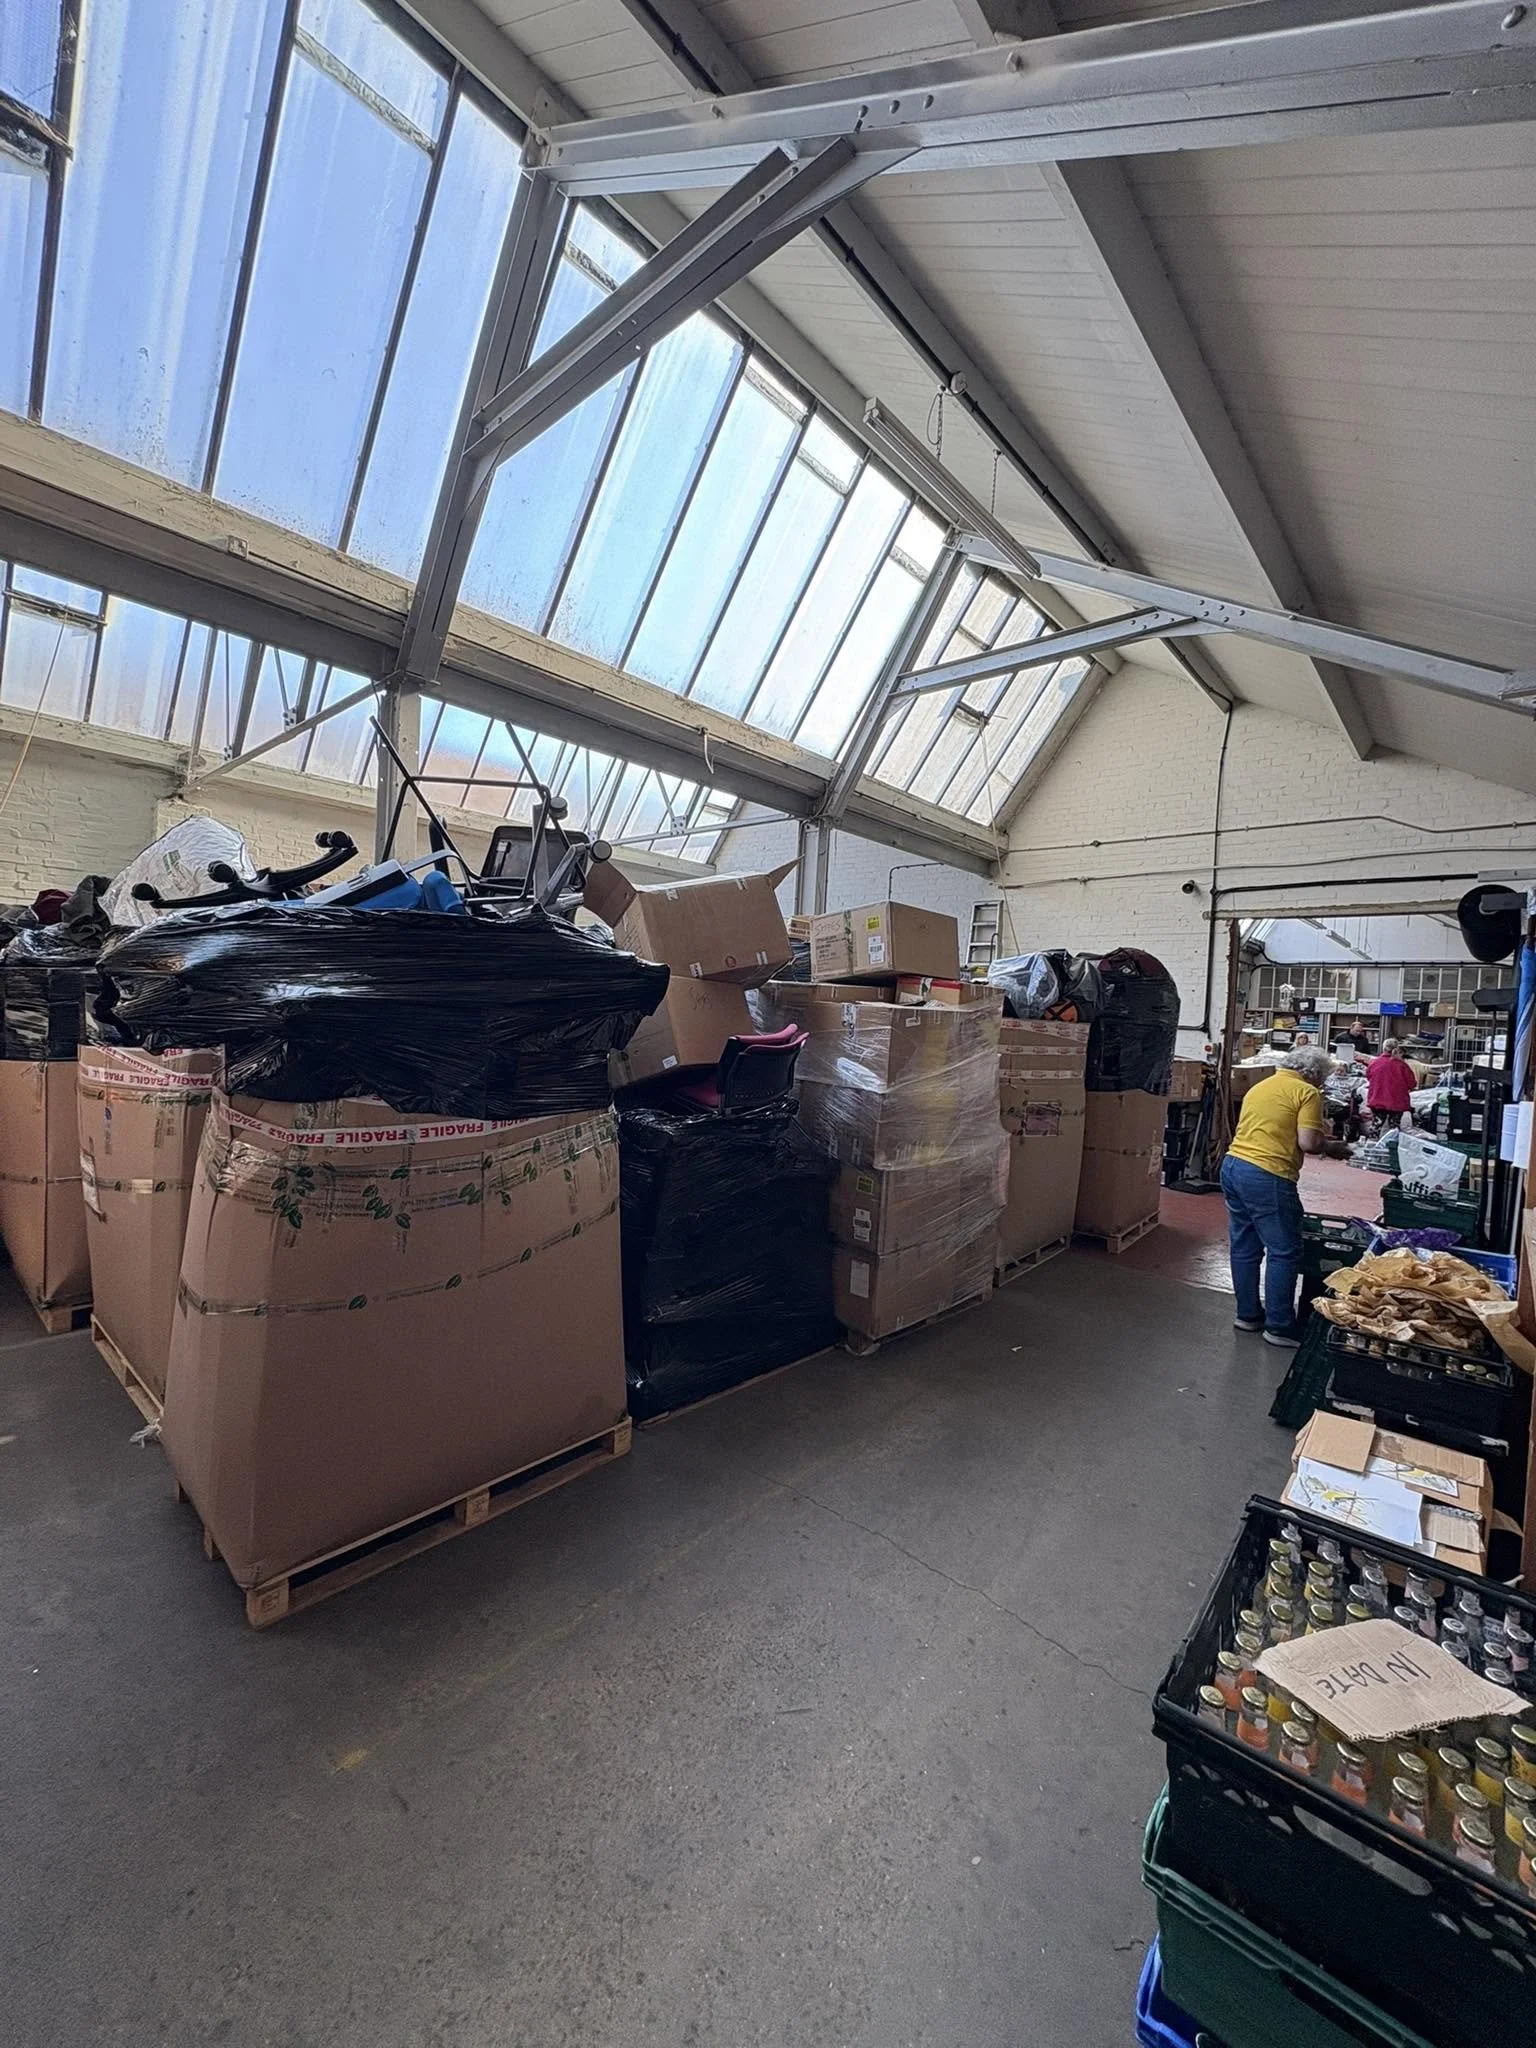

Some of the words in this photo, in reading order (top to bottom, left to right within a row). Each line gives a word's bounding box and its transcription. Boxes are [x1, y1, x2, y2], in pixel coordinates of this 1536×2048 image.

[268, 1127, 325, 1144] FRAGILE
[335, 1129, 407, 1143] FRAGILE
[419, 1122, 484, 1138] FRAGILE
[1386, 1651, 1432, 1682] IN
[1315, 1662, 1389, 1699] DATE
